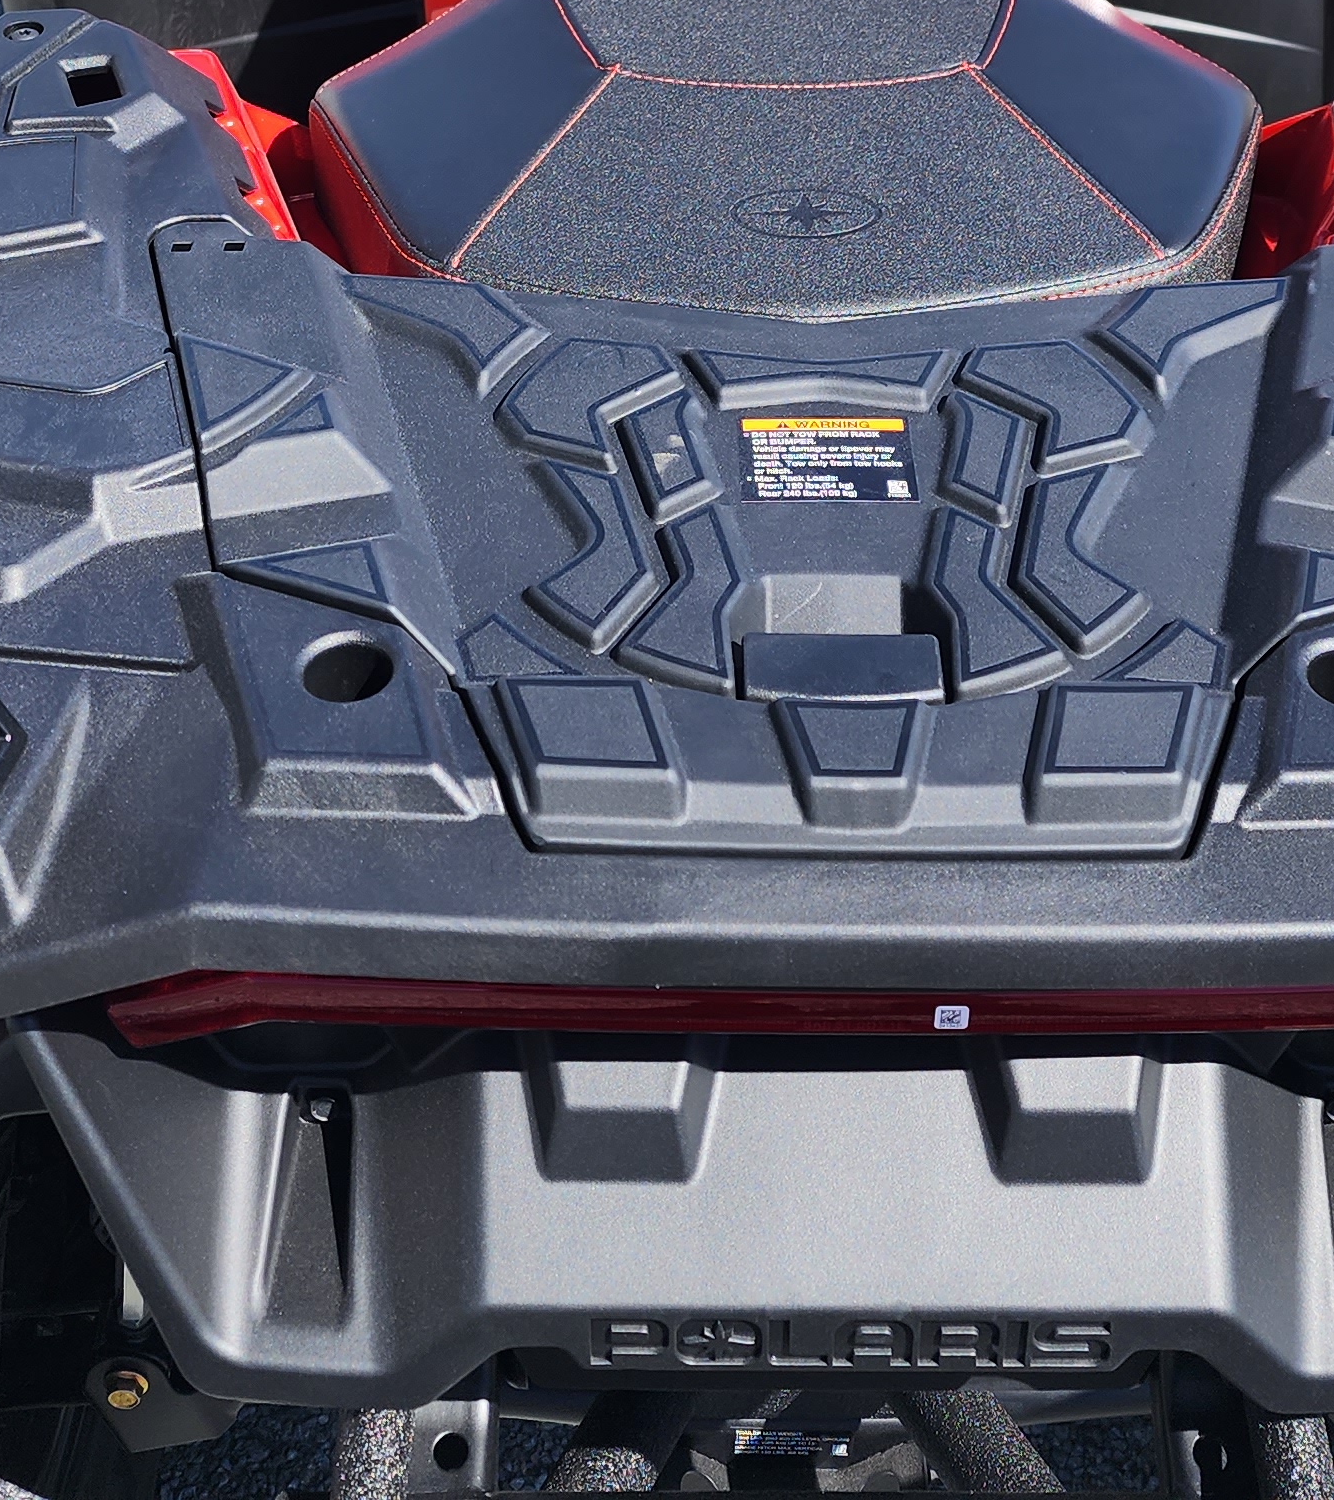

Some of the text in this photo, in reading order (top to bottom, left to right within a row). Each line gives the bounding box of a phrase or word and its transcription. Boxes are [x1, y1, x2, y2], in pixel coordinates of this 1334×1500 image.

[794, 421, 870, 429] WARNING
[788, 445, 827, 453] damage
[808, 460, 829, 468] only
[873, 460, 903, 468] hooks
[589, 1318, 1112, 1367] POLARIS
